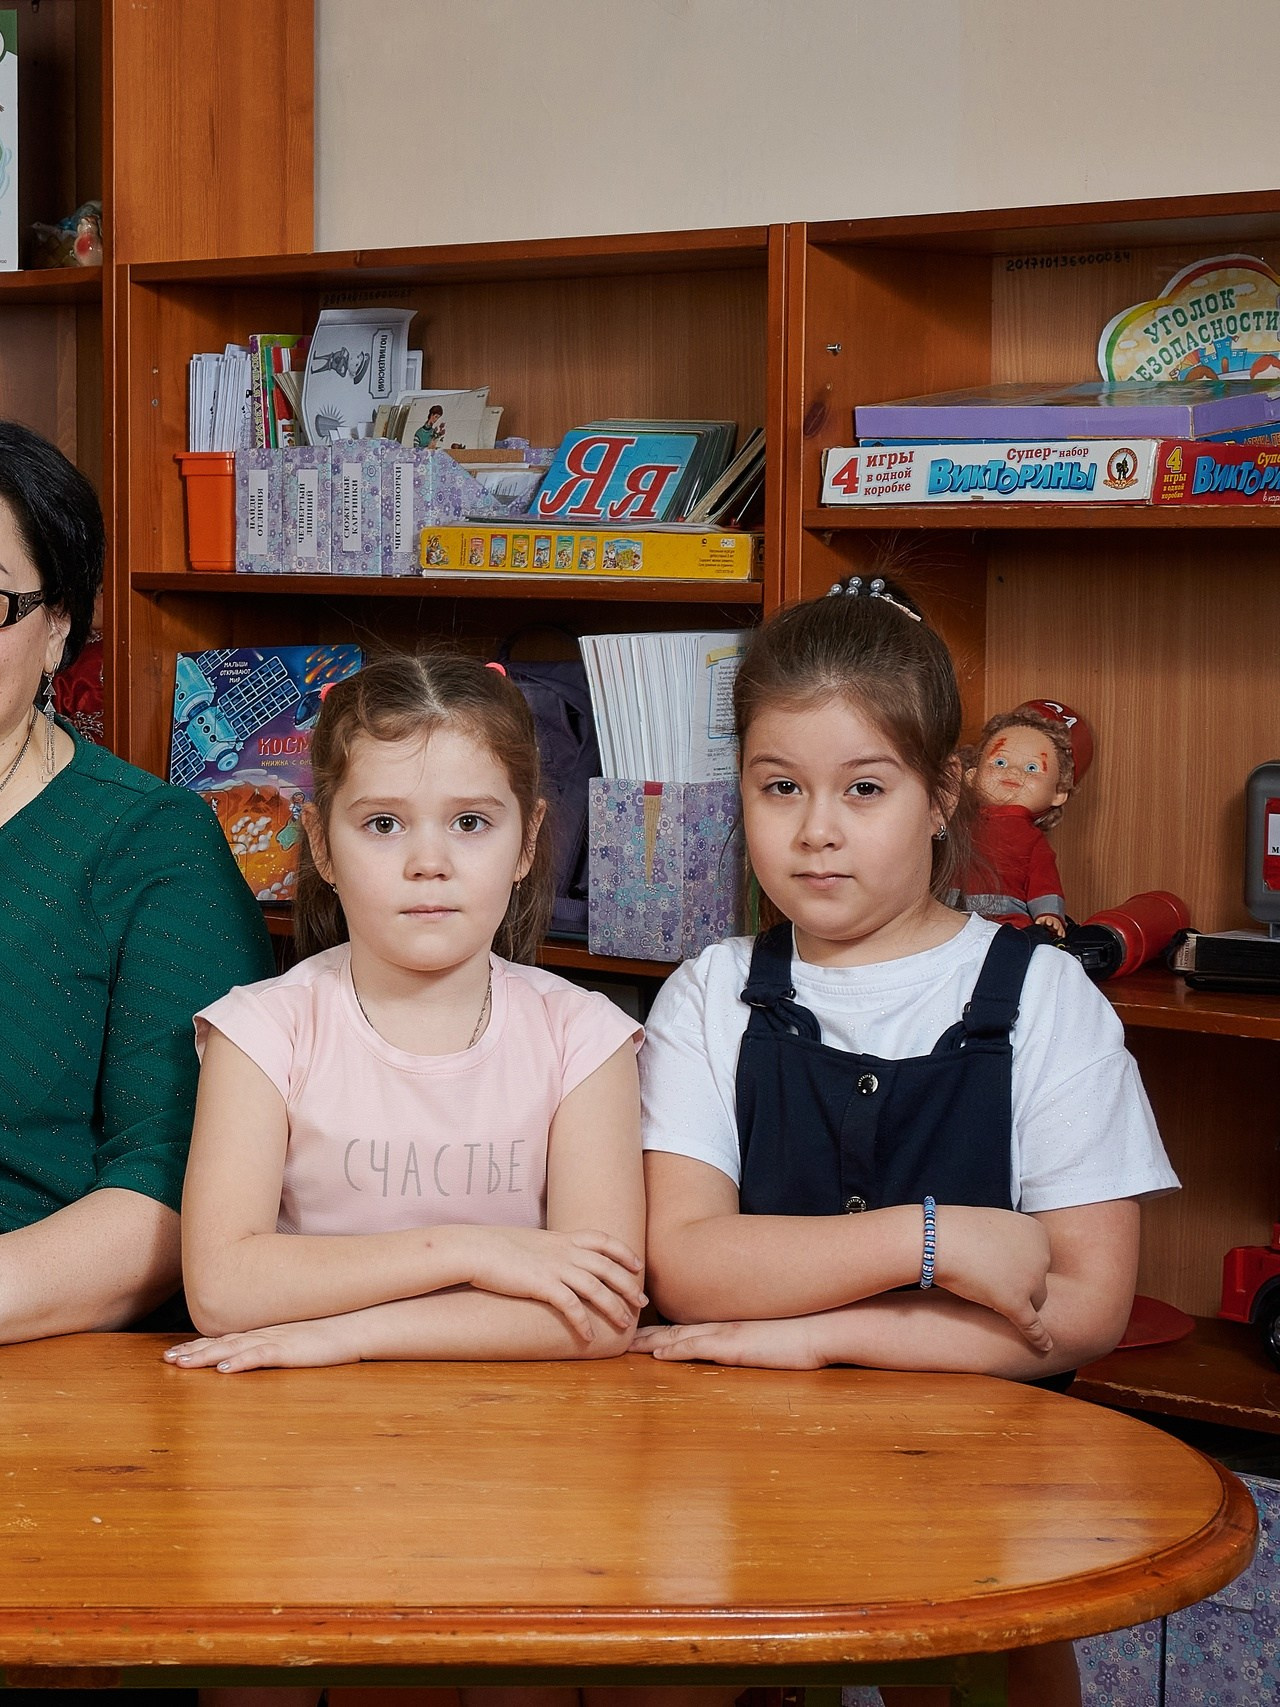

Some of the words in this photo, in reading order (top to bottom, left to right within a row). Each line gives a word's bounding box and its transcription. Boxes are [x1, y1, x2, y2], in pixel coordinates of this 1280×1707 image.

[1143, 288, 1236, 344] УГОЛОК
[377, 334, 388, 392] ПОЛИЦЕЙСКИЙ
[866, 450, 915, 469] игры
[1006, 446, 1089, 463] Супер-набор
[1166, 446, 1182, 473] 4
[538, 435, 638, 517] Я
[607, 464, 680, 518] я
[832, 457, 860, 495] 4
[866, 474, 873, 482] в
[876, 467, 912, 482] одной
[1163, 473, 1187, 484] игры
[864, 481, 911, 497] коробке
[220, 668, 252, 676] ОТКРЫВАЮТ
[343, 1138, 526, 1197] СЧАСТЬЕ
